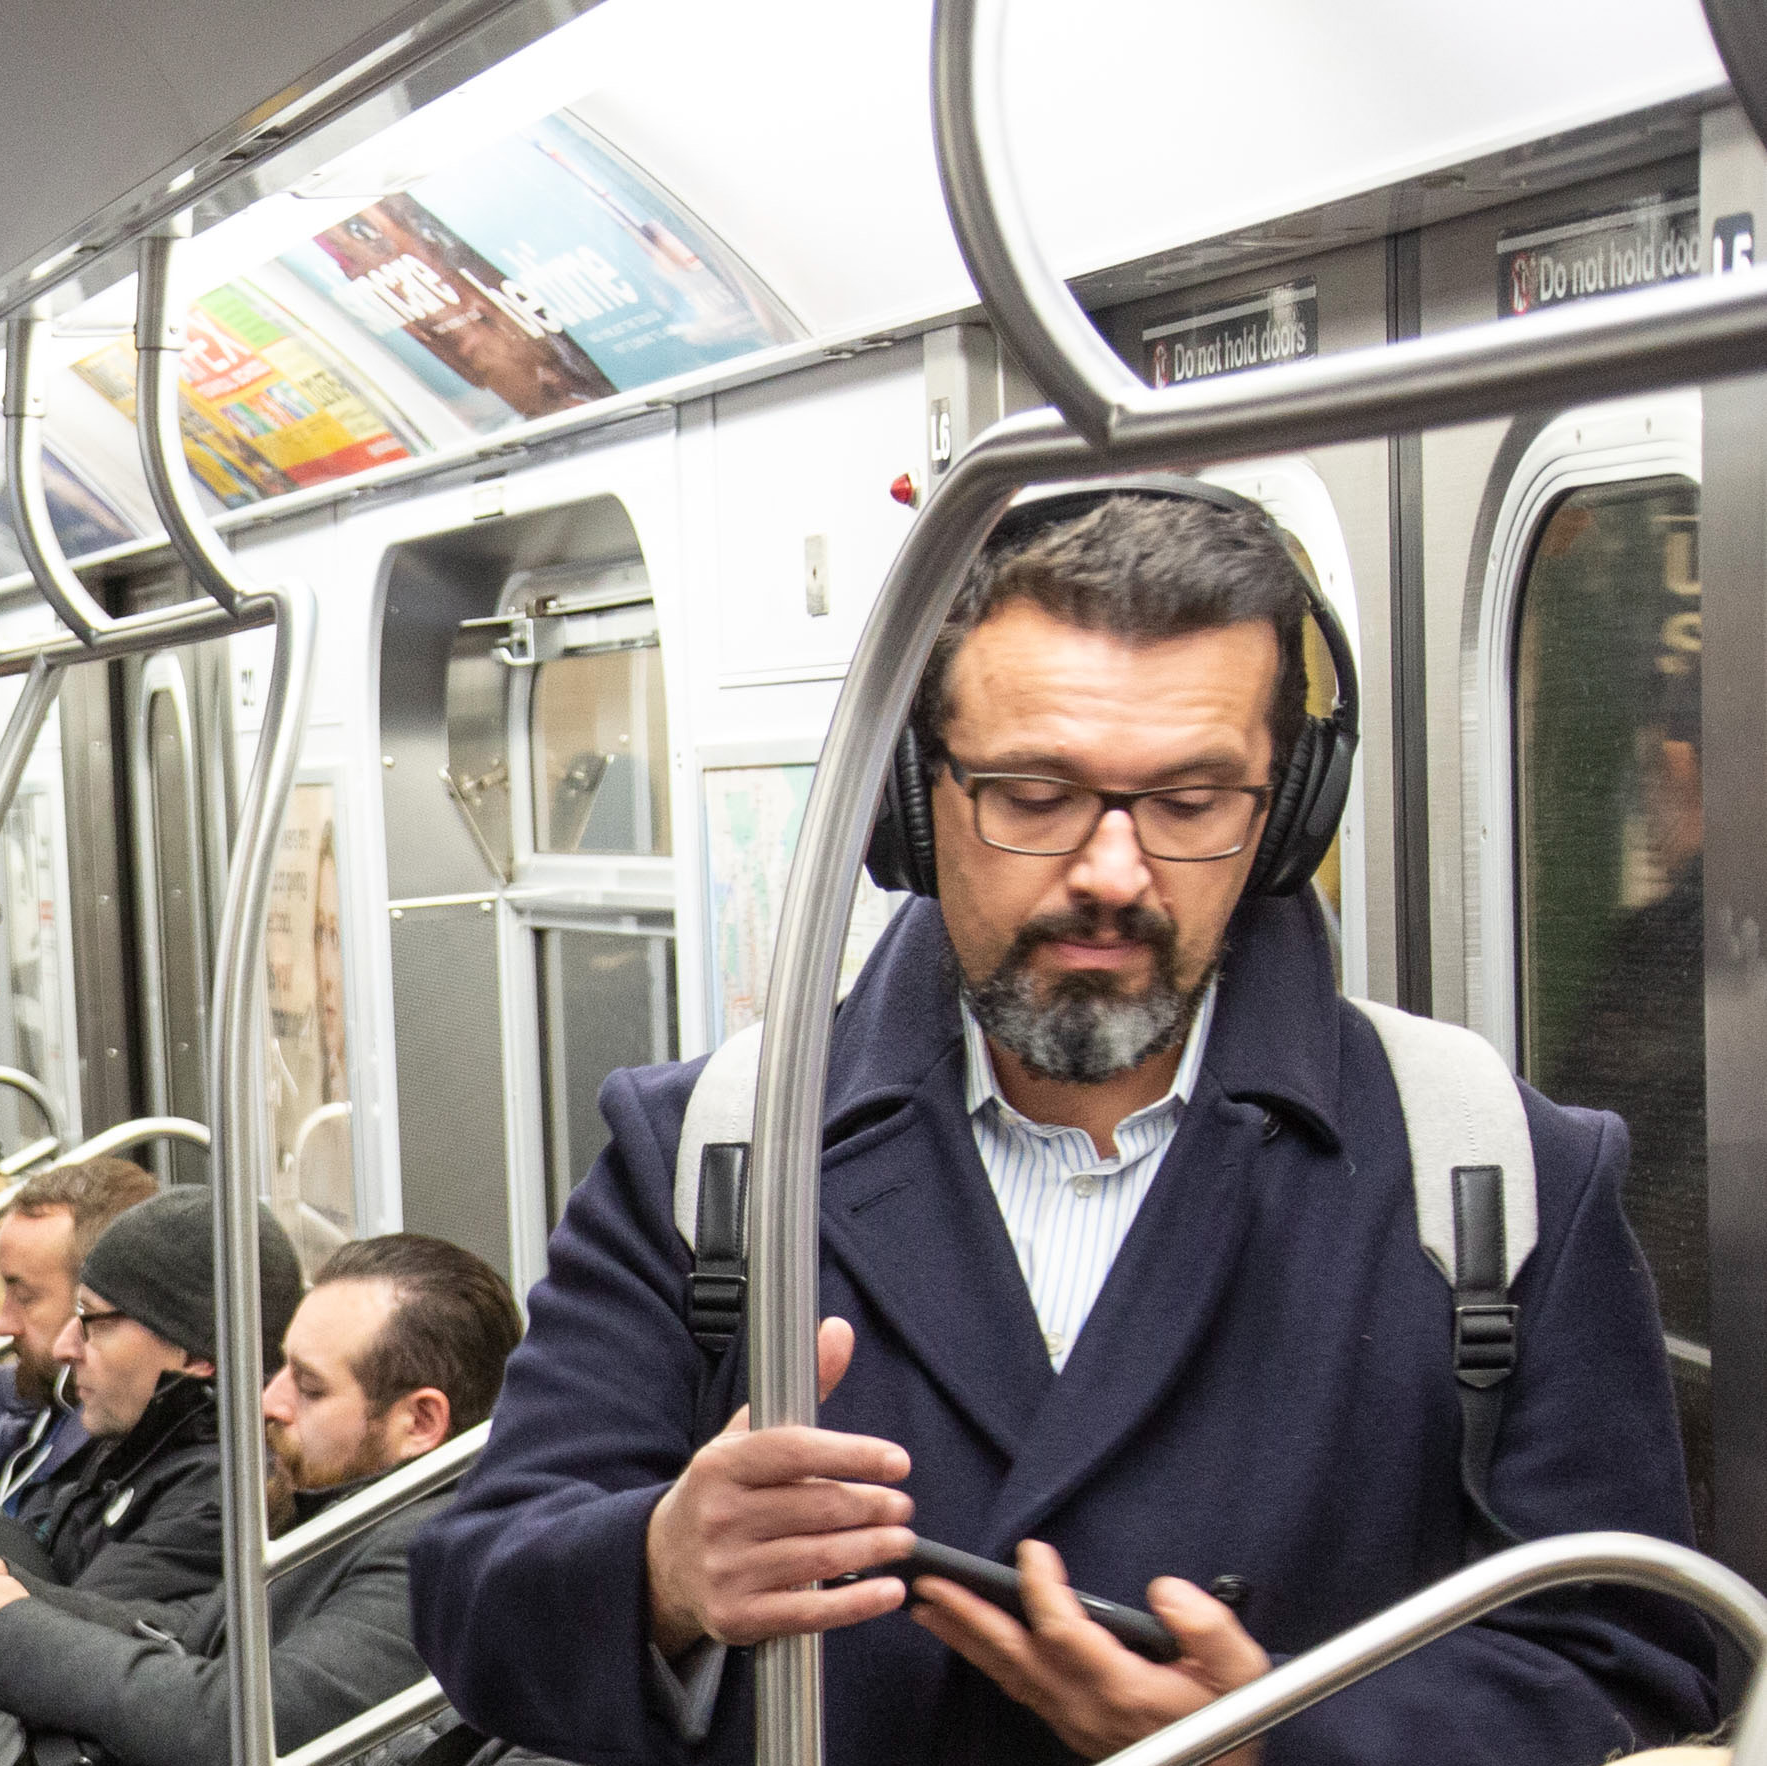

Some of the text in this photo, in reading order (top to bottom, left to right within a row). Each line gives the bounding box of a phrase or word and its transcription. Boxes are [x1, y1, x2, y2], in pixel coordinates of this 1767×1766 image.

[1540, 256, 1567, 301] Do
[1572, 249, 1605, 295] not
[1610, 240, 1656, 286] hold
[1174, 320, 1307, 382] Do not hold doors
[931, 412, 951, 461] L6
